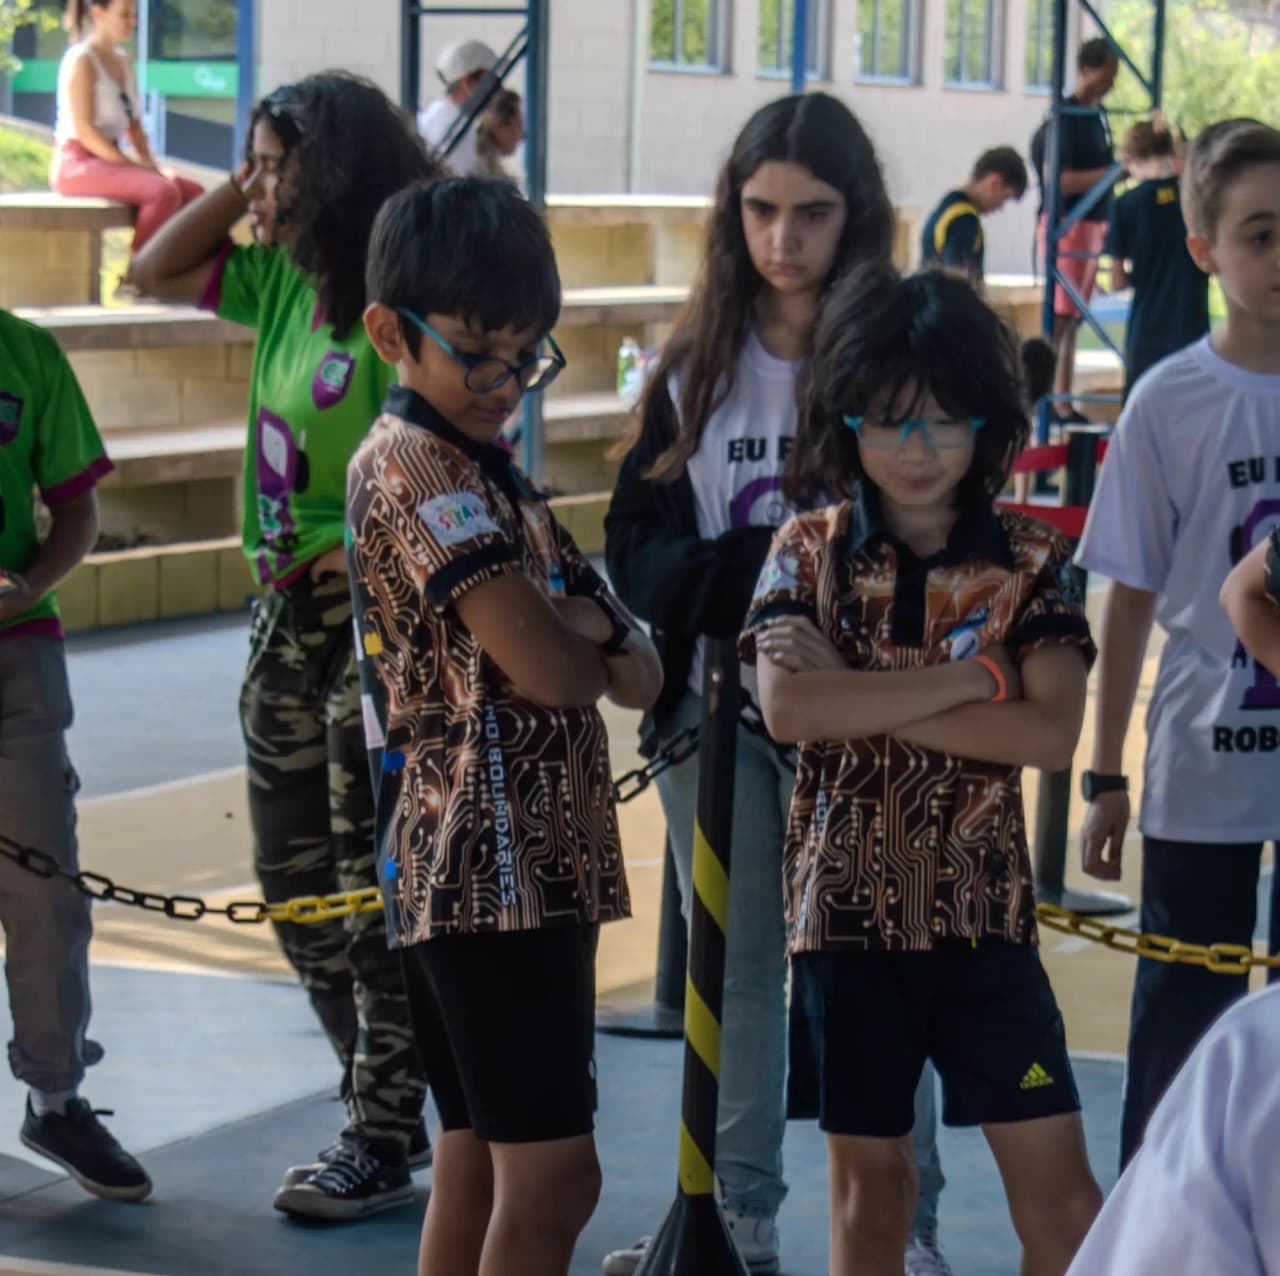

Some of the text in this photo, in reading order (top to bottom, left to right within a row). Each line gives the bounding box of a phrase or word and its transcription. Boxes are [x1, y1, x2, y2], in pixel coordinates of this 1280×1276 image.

[727, 439, 767, 463] EU
[1228, 457, 1265, 488] EU
[488, 746, 517, 908] BOUNDARIES
